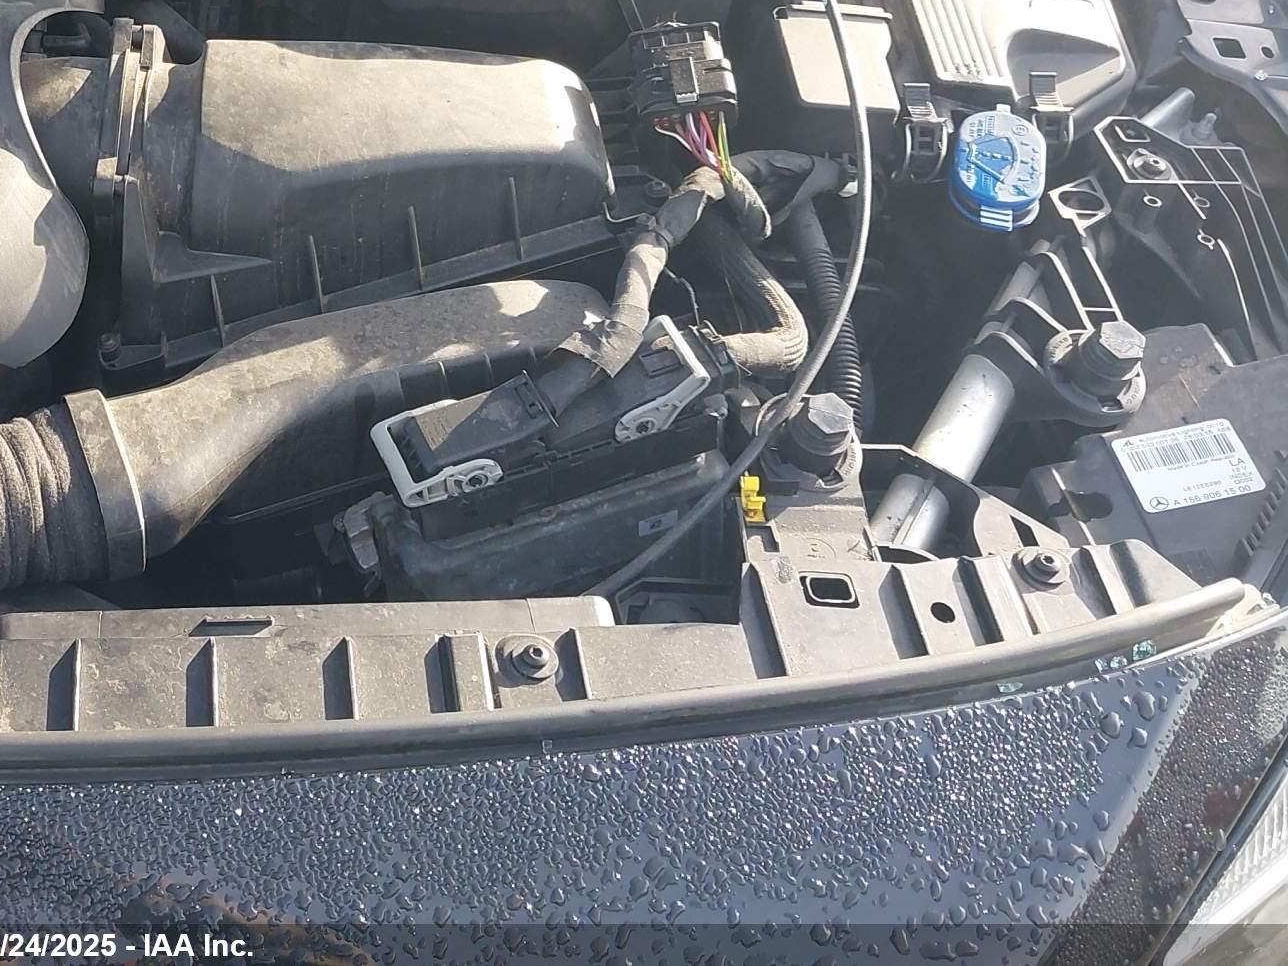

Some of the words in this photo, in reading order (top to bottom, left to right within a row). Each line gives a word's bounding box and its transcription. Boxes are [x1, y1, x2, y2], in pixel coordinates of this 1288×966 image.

[1229, 457, 1246, 467] LA
[1224, 487, 1237, 496] 15
[1238, 484, 1252, 493] 00
